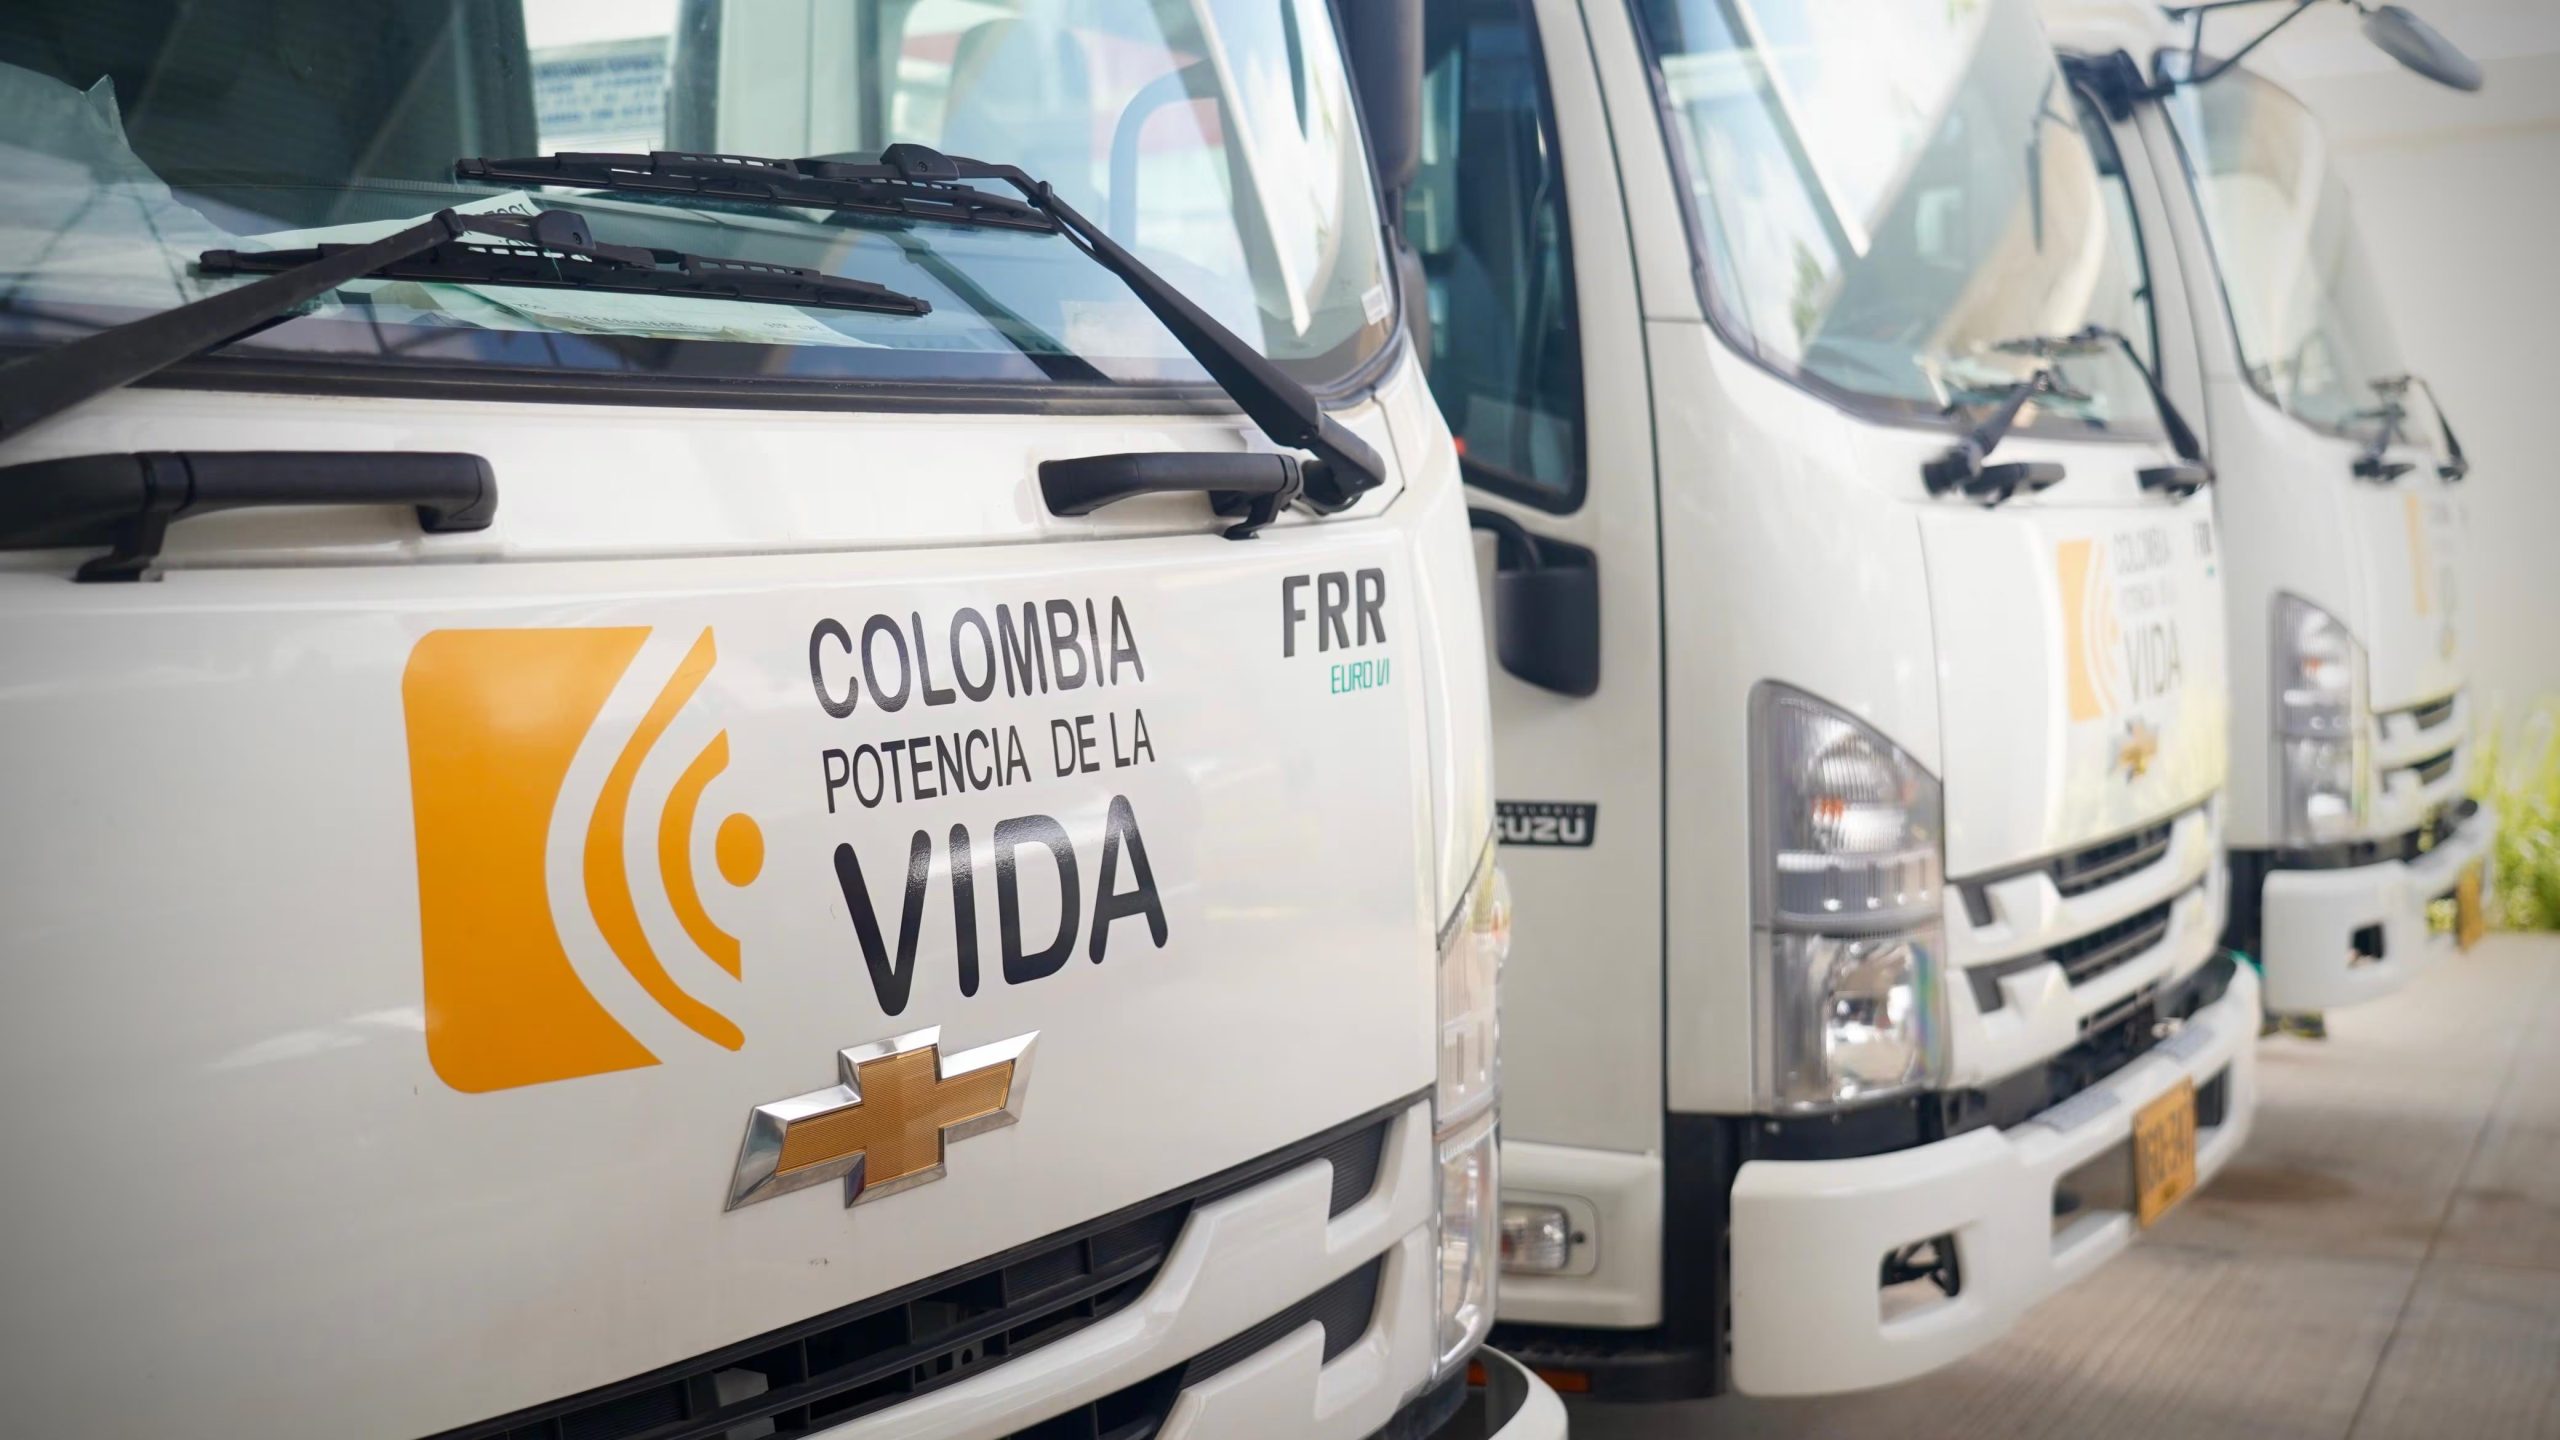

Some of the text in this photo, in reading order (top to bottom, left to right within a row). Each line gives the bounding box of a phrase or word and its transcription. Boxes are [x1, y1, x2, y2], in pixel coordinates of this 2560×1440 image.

[809, 595, 1145, 719] COLOMBIA
[1282, 567, 1387, 658] FRR
[2123, 617, 2184, 704] VIDA
[1331, 657, 1390, 694] EURO VI
[822, 708, 1156, 814] POTENCIA DE LA
[834, 794, 1169, 1017] VIDA
